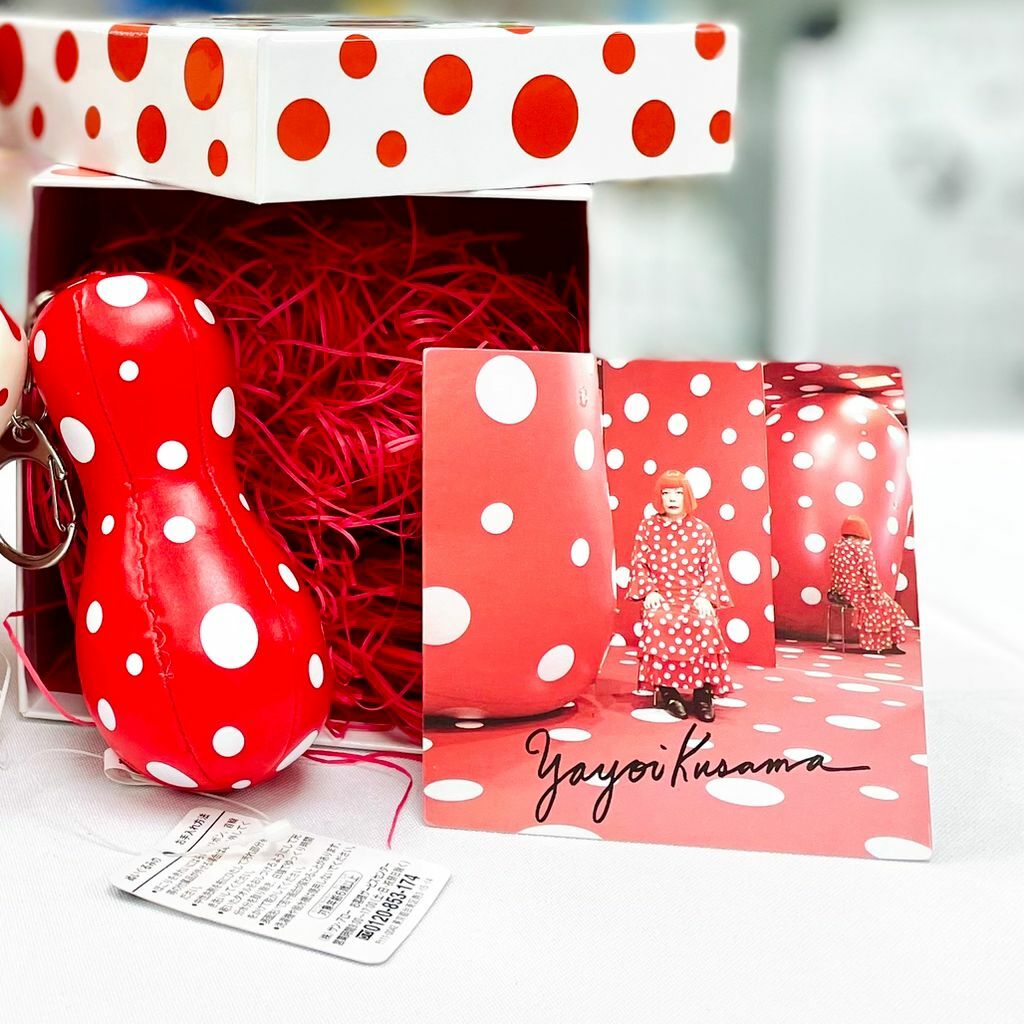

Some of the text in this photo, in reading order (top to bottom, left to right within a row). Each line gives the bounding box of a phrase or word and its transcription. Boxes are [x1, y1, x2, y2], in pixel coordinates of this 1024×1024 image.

[525, 723, 871, 823] Yayoi Kusama
[173, 812, 211, 845] お手入れ方法
[362, 873, 420, 932] 0120-853-174
